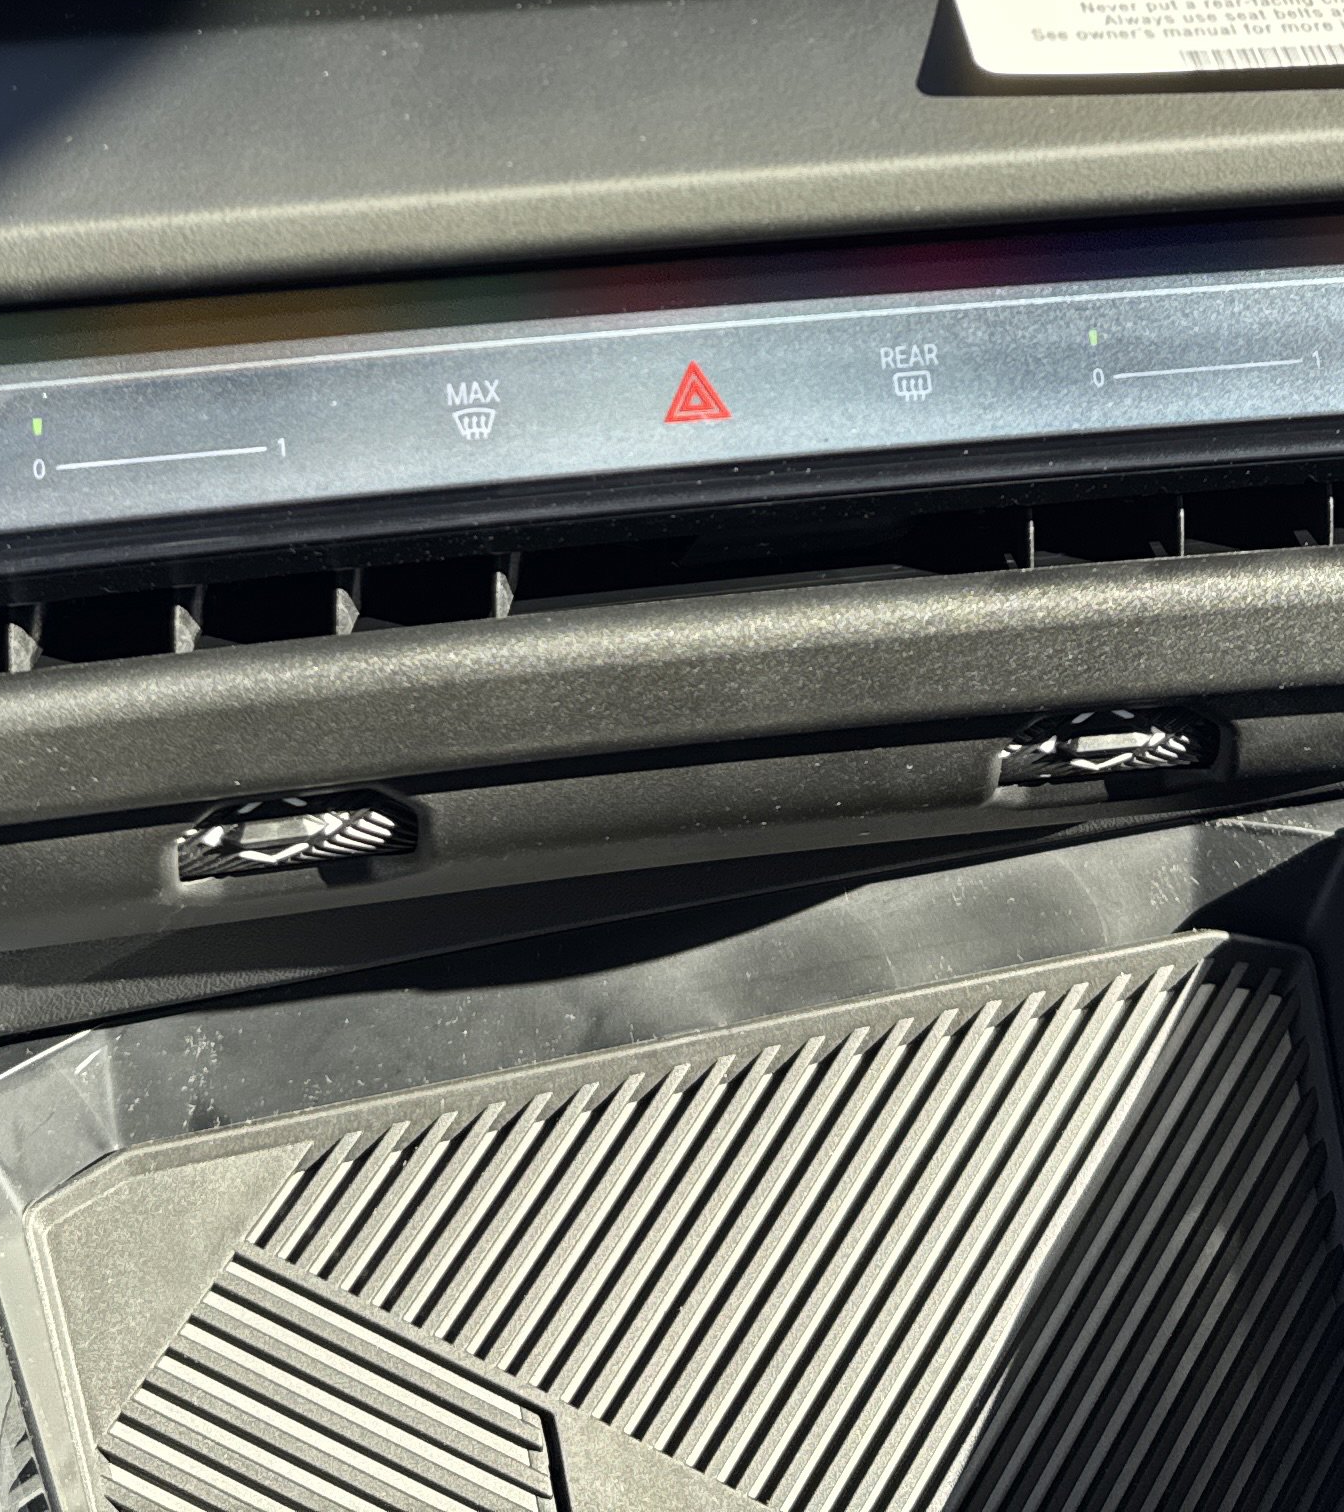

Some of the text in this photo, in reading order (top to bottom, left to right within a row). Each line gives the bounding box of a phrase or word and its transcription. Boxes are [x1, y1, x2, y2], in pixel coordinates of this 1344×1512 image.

[880, 343, 939, 370] REAR
[1092, 368, 1104, 387] 0
[446, 379, 500, 405] MAX
[33, 458, 46, 479] 0
